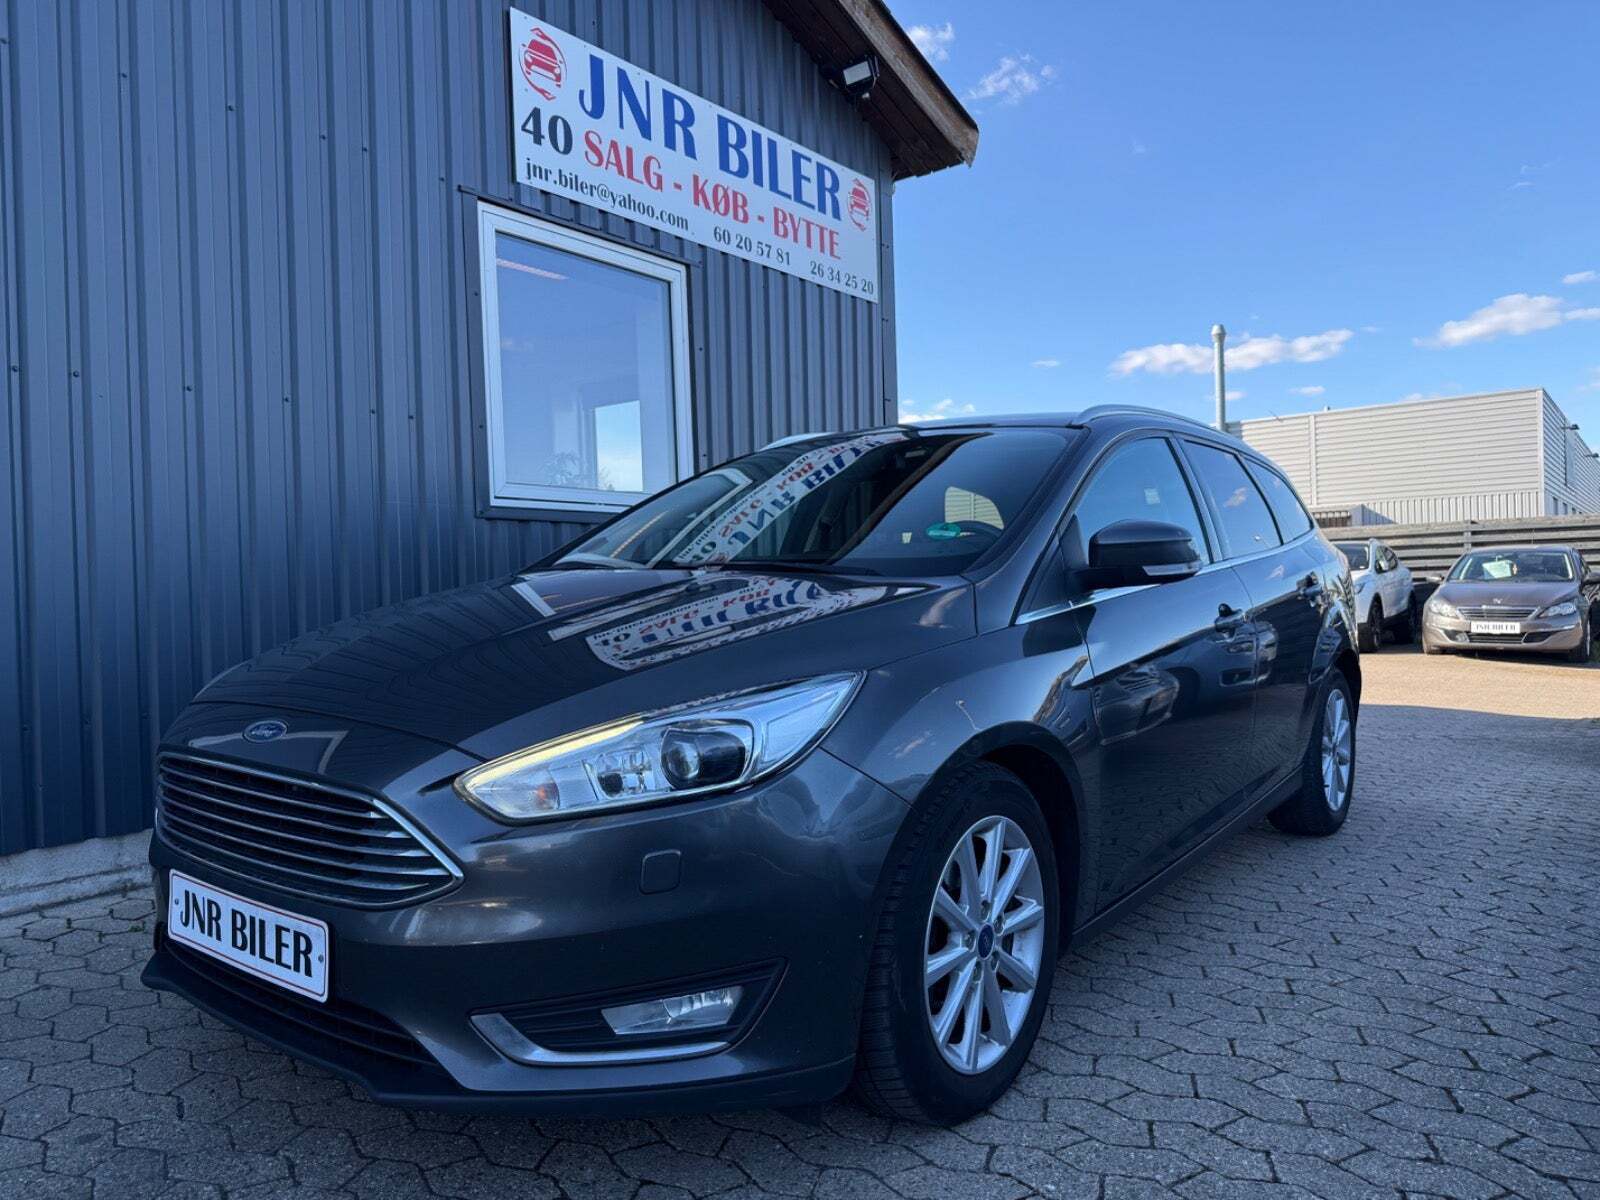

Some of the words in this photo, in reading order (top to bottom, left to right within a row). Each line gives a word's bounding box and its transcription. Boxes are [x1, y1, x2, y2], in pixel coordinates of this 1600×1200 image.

[520, 106, 574, 156] 40
[578, 53, 698, 161] JNR
[716, 113, 842, 222] BILER
[525, 157, 689, 231] jnr.biler@yahoo.com
[584, 130, 663, 193] SALG
[692, 174, 750, 224] KØB
[773, 206, 841, 260] BYTTE
[713, 225, 731, 246] 60
[735, 233, 752, 252] 20
[756, 241, 772, 259] 57
[776, 250, 791, 266] 81
[810, 260, 825, 278] 26
[827, 267, 841, 284] 34
[844, 272, 858, 290] 25
[861, 278, 874, 295] 20
[179, 889, 223, 942] JNR
[231, 908, 314, 978] BILER
